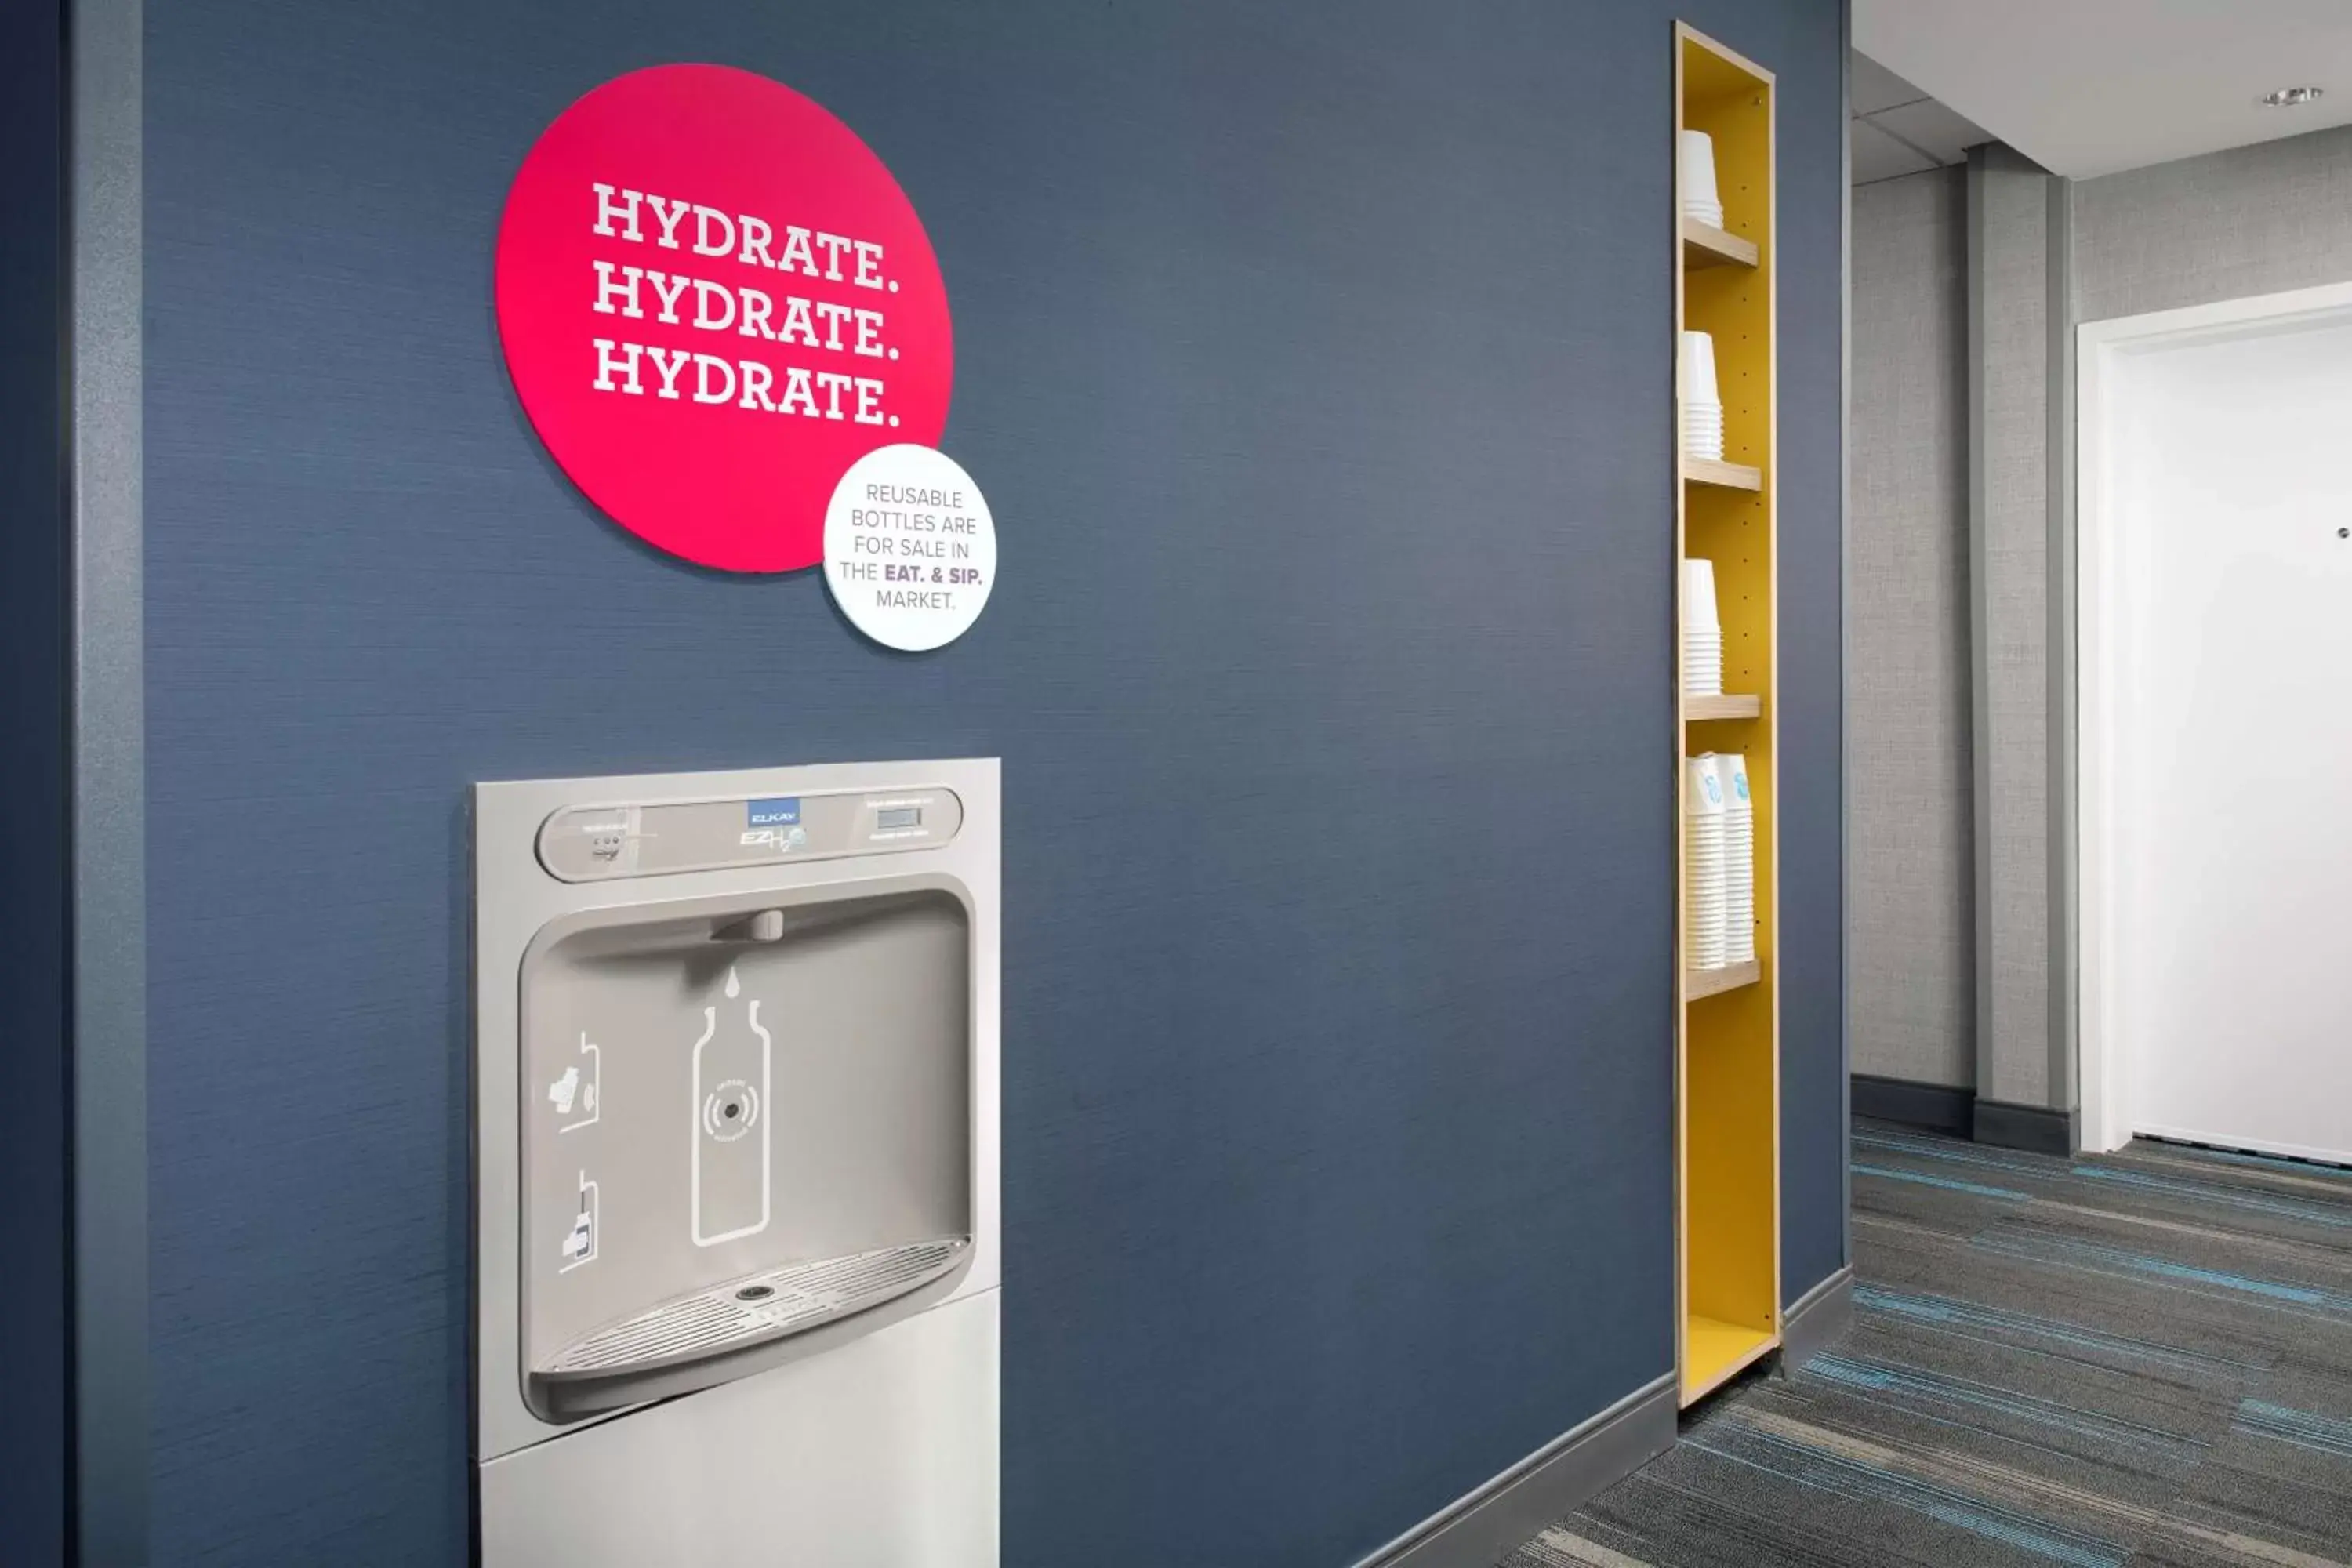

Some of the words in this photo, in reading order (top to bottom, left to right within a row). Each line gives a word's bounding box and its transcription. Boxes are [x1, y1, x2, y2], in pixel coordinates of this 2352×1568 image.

[593, 183, 900, 294] HYDRATE.
[593, 260, 900, 361] HYDRATE.
[593, 338, 901, 427] HYDRATE.
[866, 484, 963, 509] REUSABLE
[851, 509, 935, 532] BOTTLES
[942, 516, 976, 535] ARE
[855, 535, 894, 554] FOR
[900, 539, 945, 558] SALE
[951, 543, 969, 559] IN
[840, 561, 877, 581] THE
[884, 564, 925, 583] EAT.
[930, 567, 943, 583] &
[949, 567, 983, 586] SIP.
[876, 590, 957, 611] MARKET.
[751, 812, 797, 822] ELKAY
